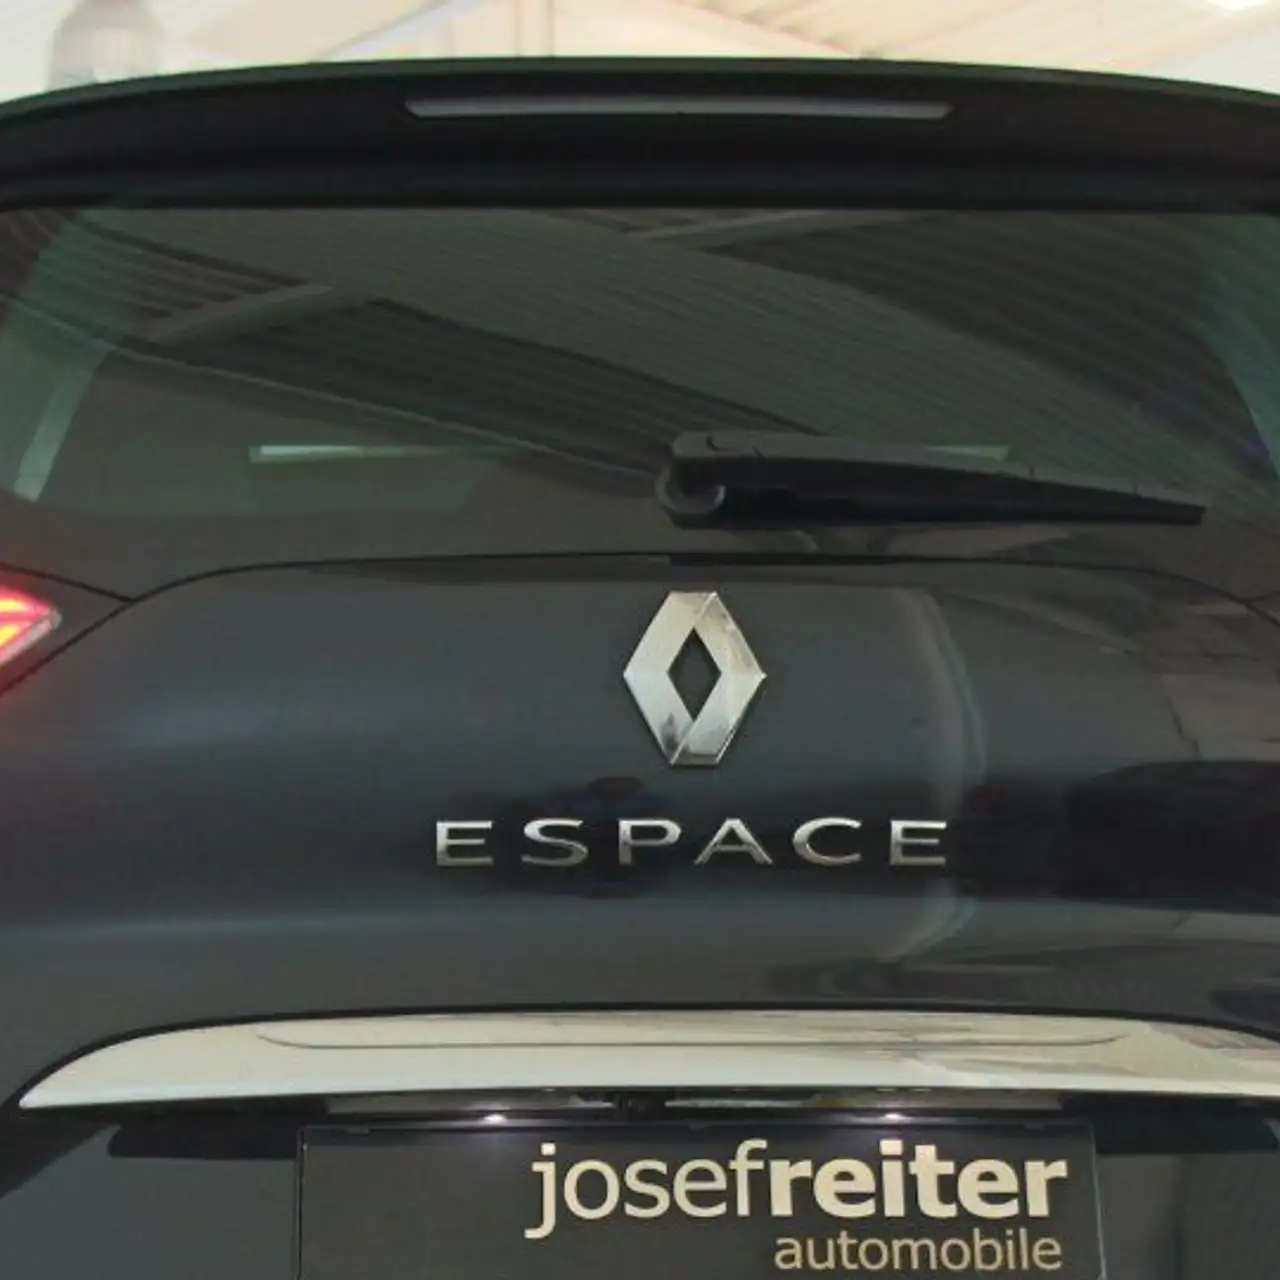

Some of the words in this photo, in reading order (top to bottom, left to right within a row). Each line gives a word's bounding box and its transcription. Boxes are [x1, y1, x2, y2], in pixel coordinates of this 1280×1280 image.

[436, 817, 947, 866] ESPACE
[524, 1138, 1068, 1239] josefreiter
[774, 1228, 1063, 1271] automobile
